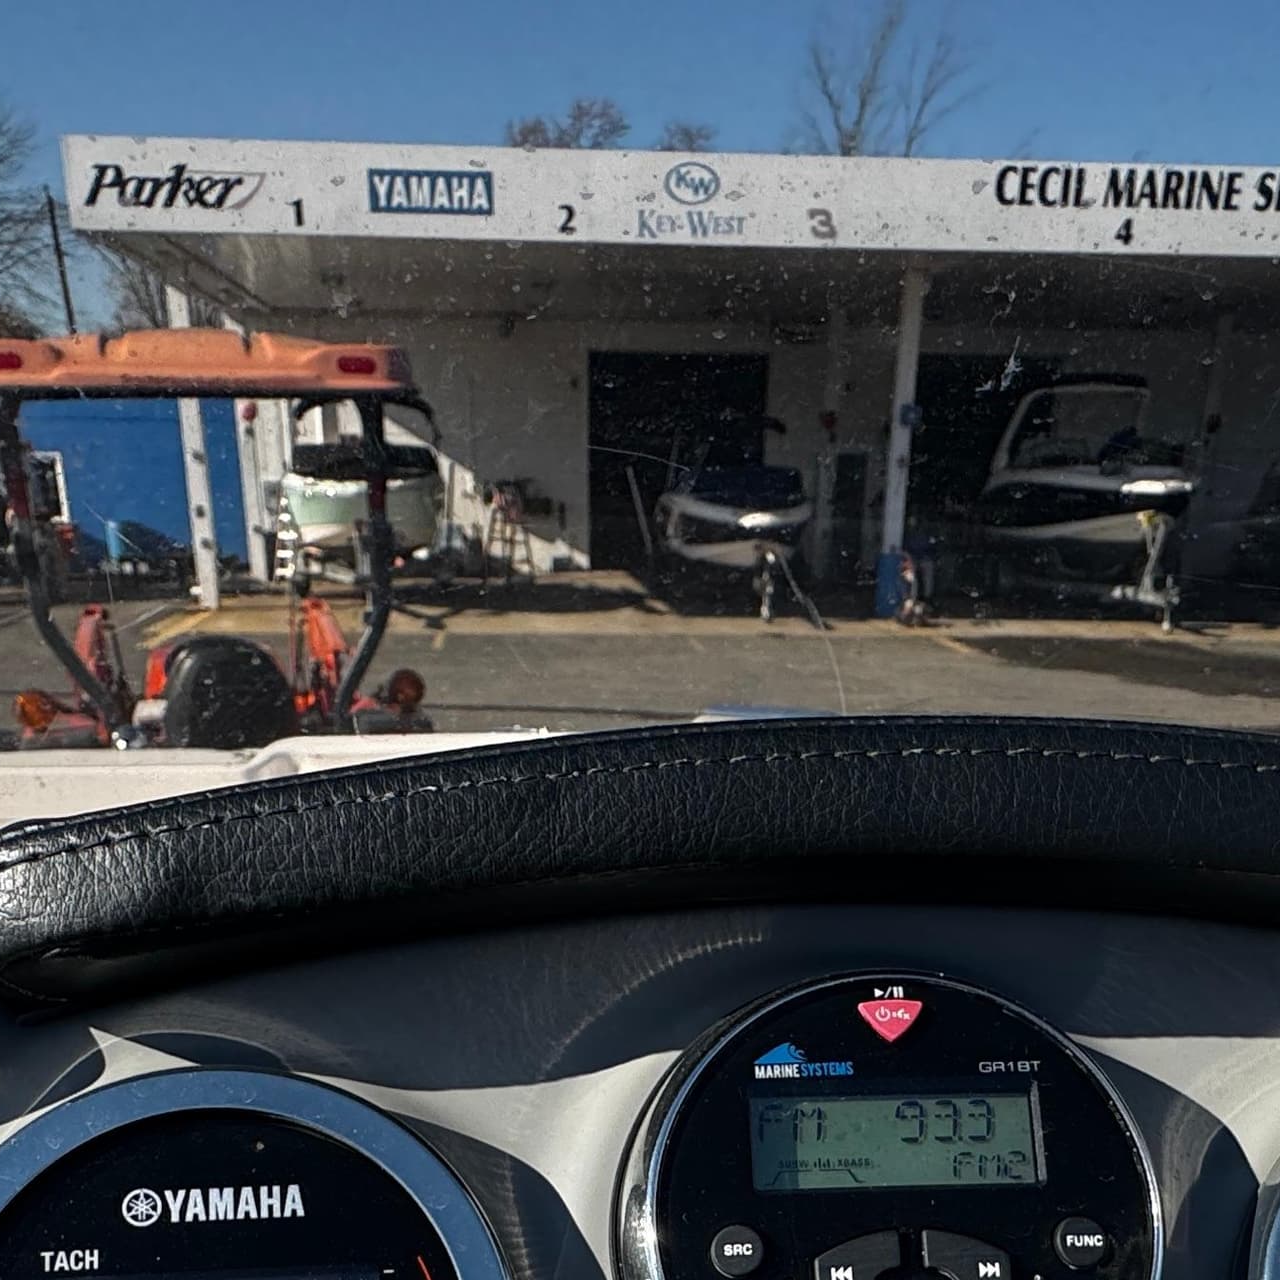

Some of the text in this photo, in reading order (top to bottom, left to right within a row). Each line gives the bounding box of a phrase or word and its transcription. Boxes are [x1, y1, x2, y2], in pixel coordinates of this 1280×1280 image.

[83, 162, 244, 210] Parker
[372, 172, 490, 212] YAMAHA
[995, 165, 1093, 208] CECIL
[1103, 168, 1243, 212] MARINE
[285, 198, 306, 227] 1
[558, 204, 577, 234] 2
[809, 207, 836, 240] 3
[1116, 218, 1134, 246] 4
[978, 1060, 1041, 1074] GR1BT
[164, 1183, 306, 1223] YAMAHA
[723, 1242, 753, 1257] SRC
[1065, 1233, 1104, 1249] FUNC
[40, 1249, 100, 1273] TACH
